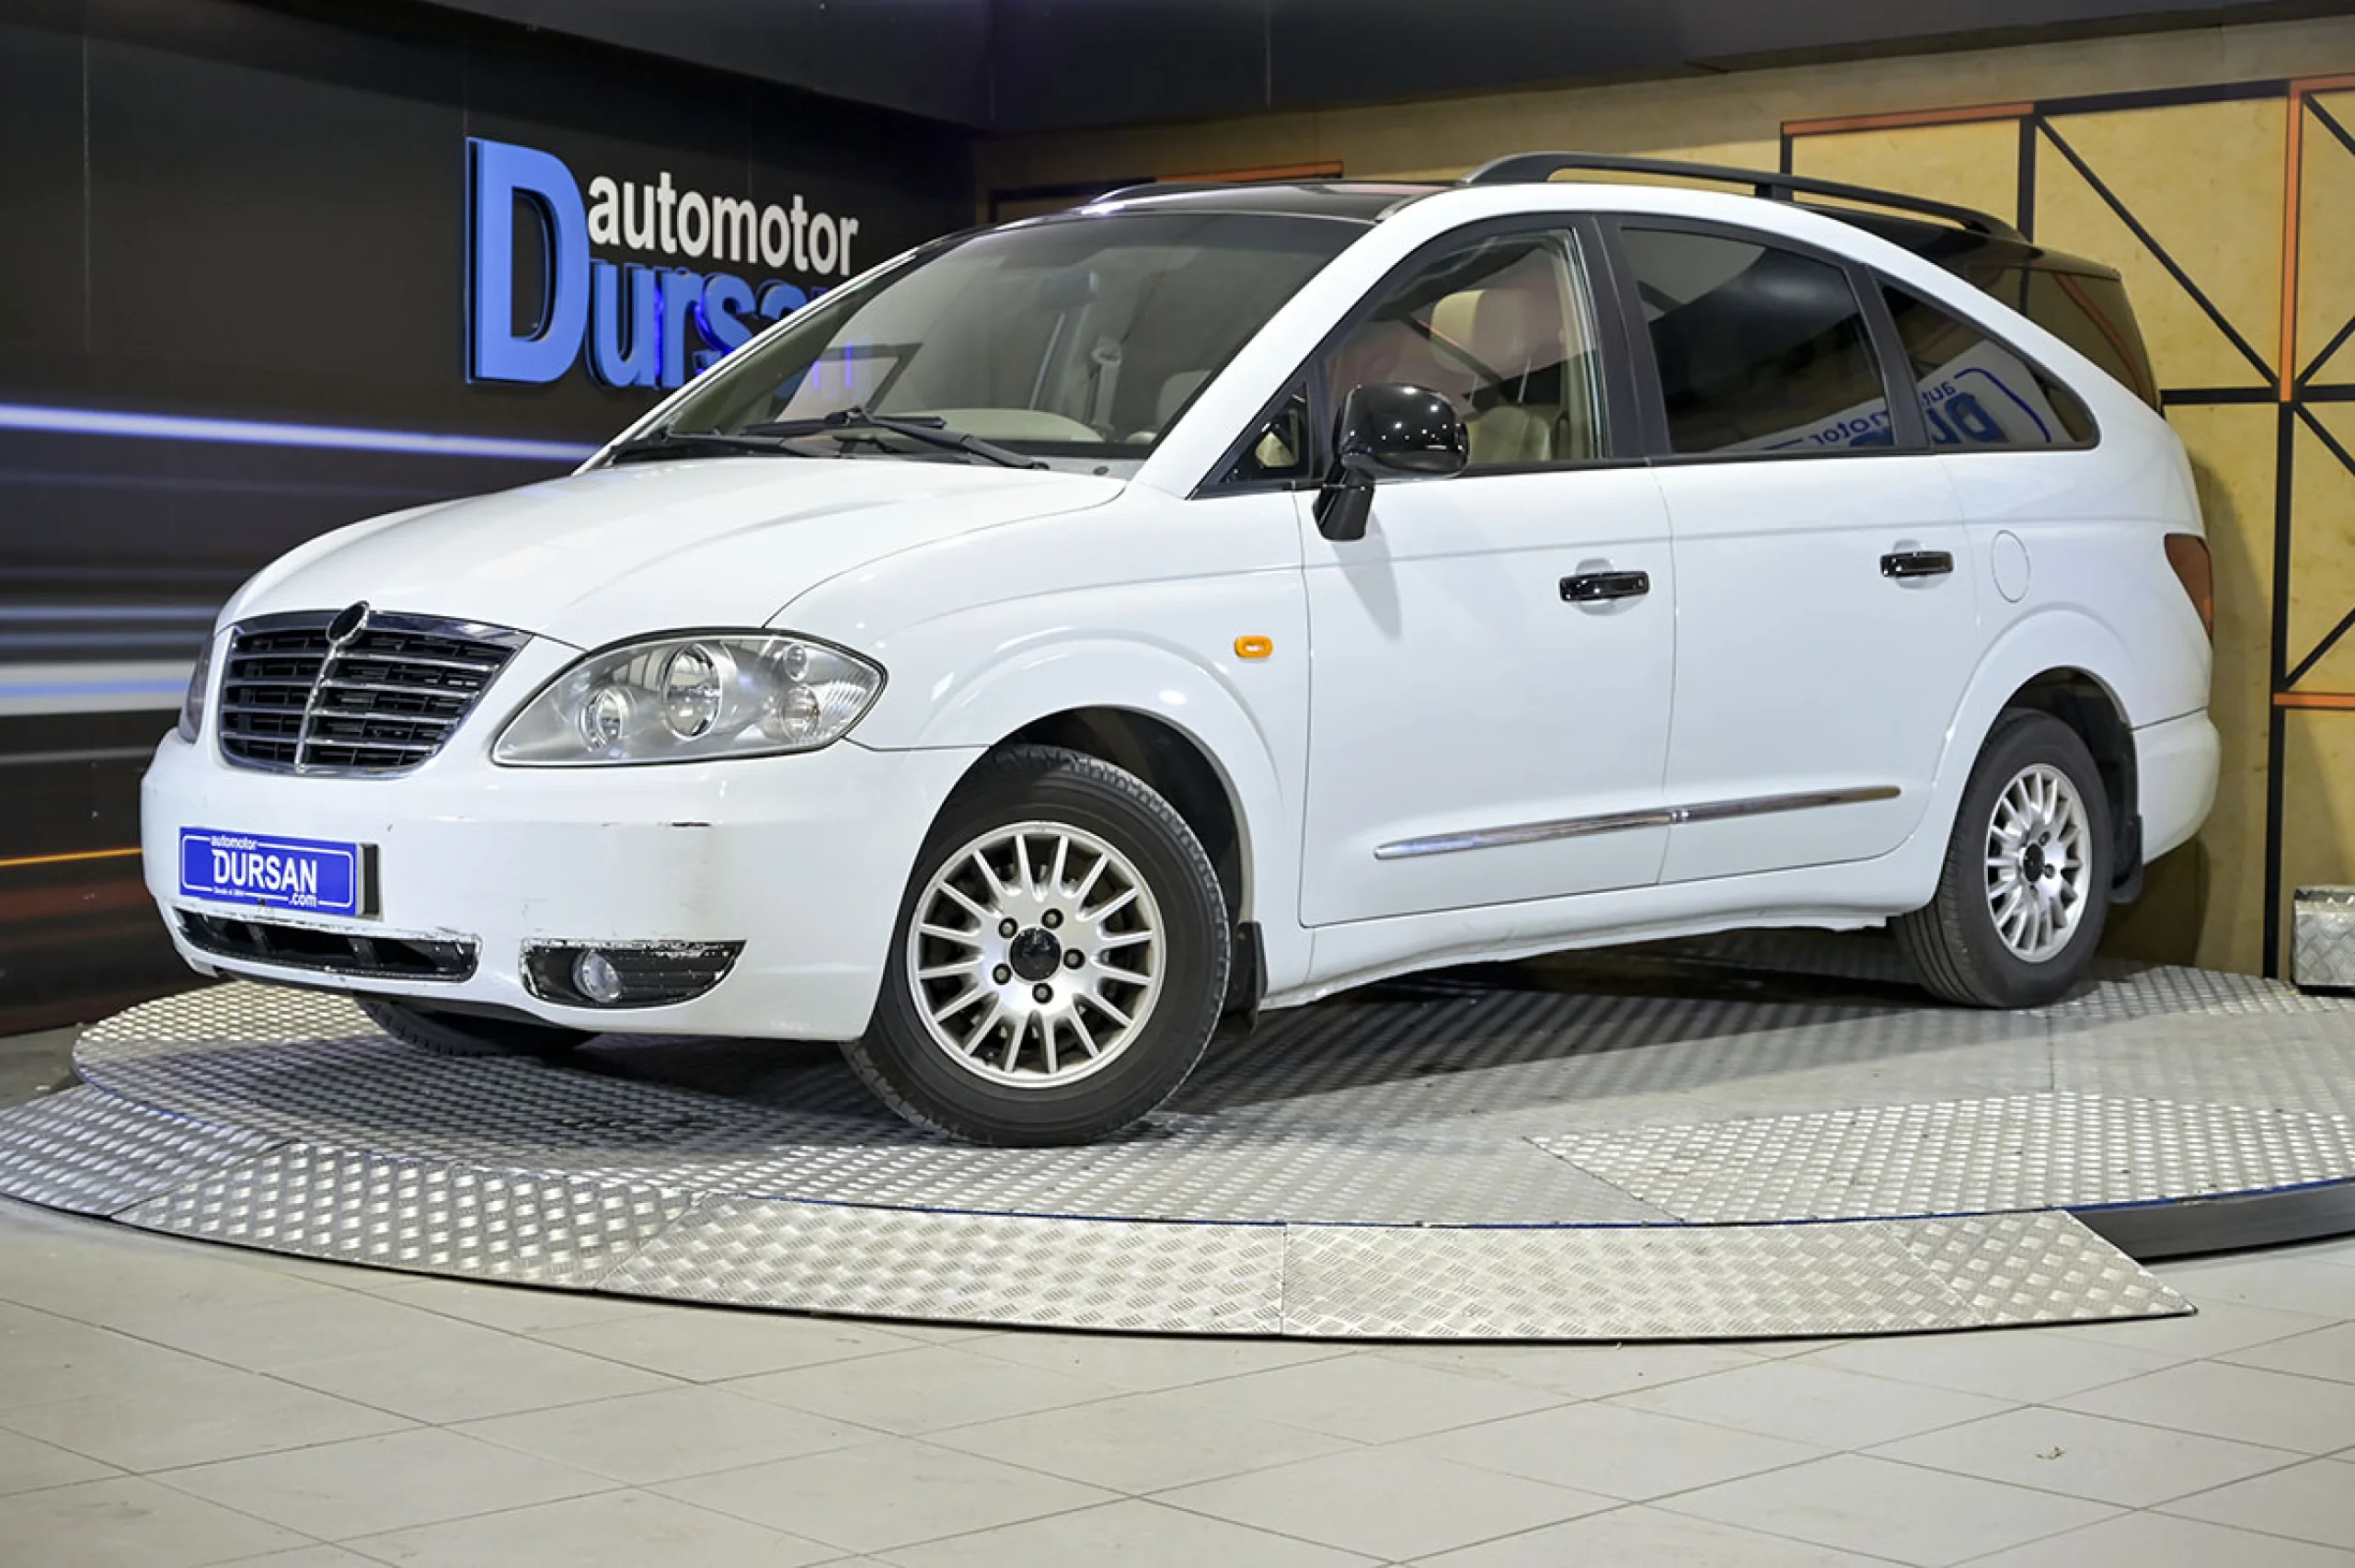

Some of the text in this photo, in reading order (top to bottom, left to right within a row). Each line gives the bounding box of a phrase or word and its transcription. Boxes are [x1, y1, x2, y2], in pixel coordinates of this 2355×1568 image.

[466, 136, 825, 390] Durs
[587, 171, 859, 275] automotor
[212, 849, 317, 895] DURSAN
